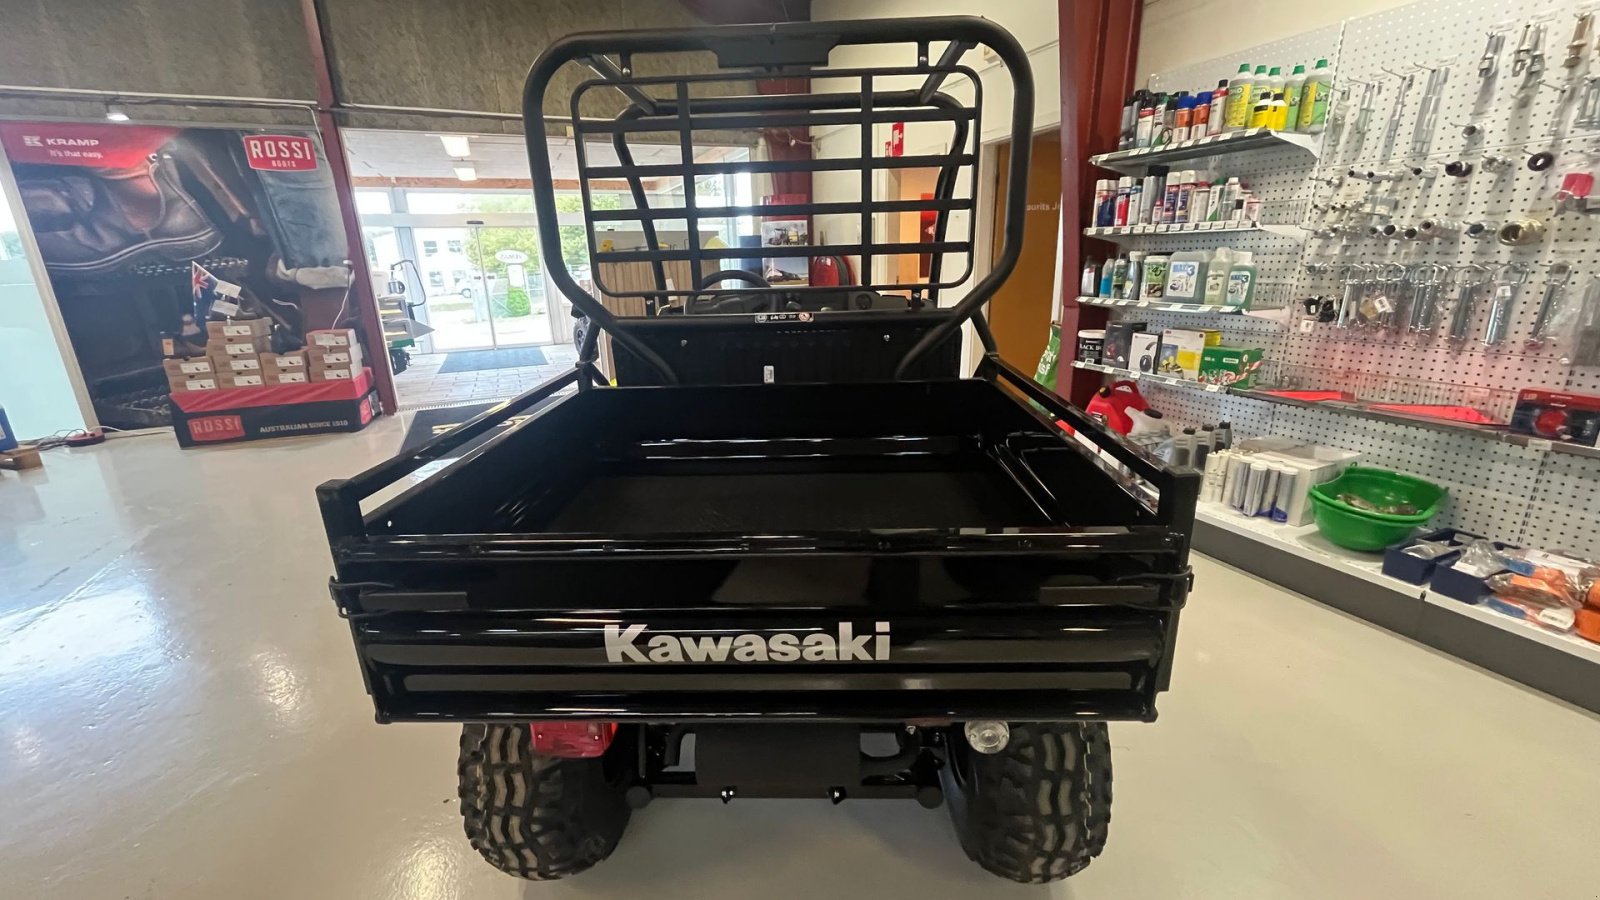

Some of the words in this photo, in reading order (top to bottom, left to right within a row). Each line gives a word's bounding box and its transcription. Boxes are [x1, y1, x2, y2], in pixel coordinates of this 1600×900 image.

[46, 138, 99, 147] KRAMP
[249, 139, 311, 160] ROSSI
[64, 150, 81, 158] that
[191, 417, 241, 434] ROSSI
[260, 423, 308, 433] AUSTRALIAN
[309, 421, 331, 429] SINCE
[604, 621, 891, 663] Kawasaki
